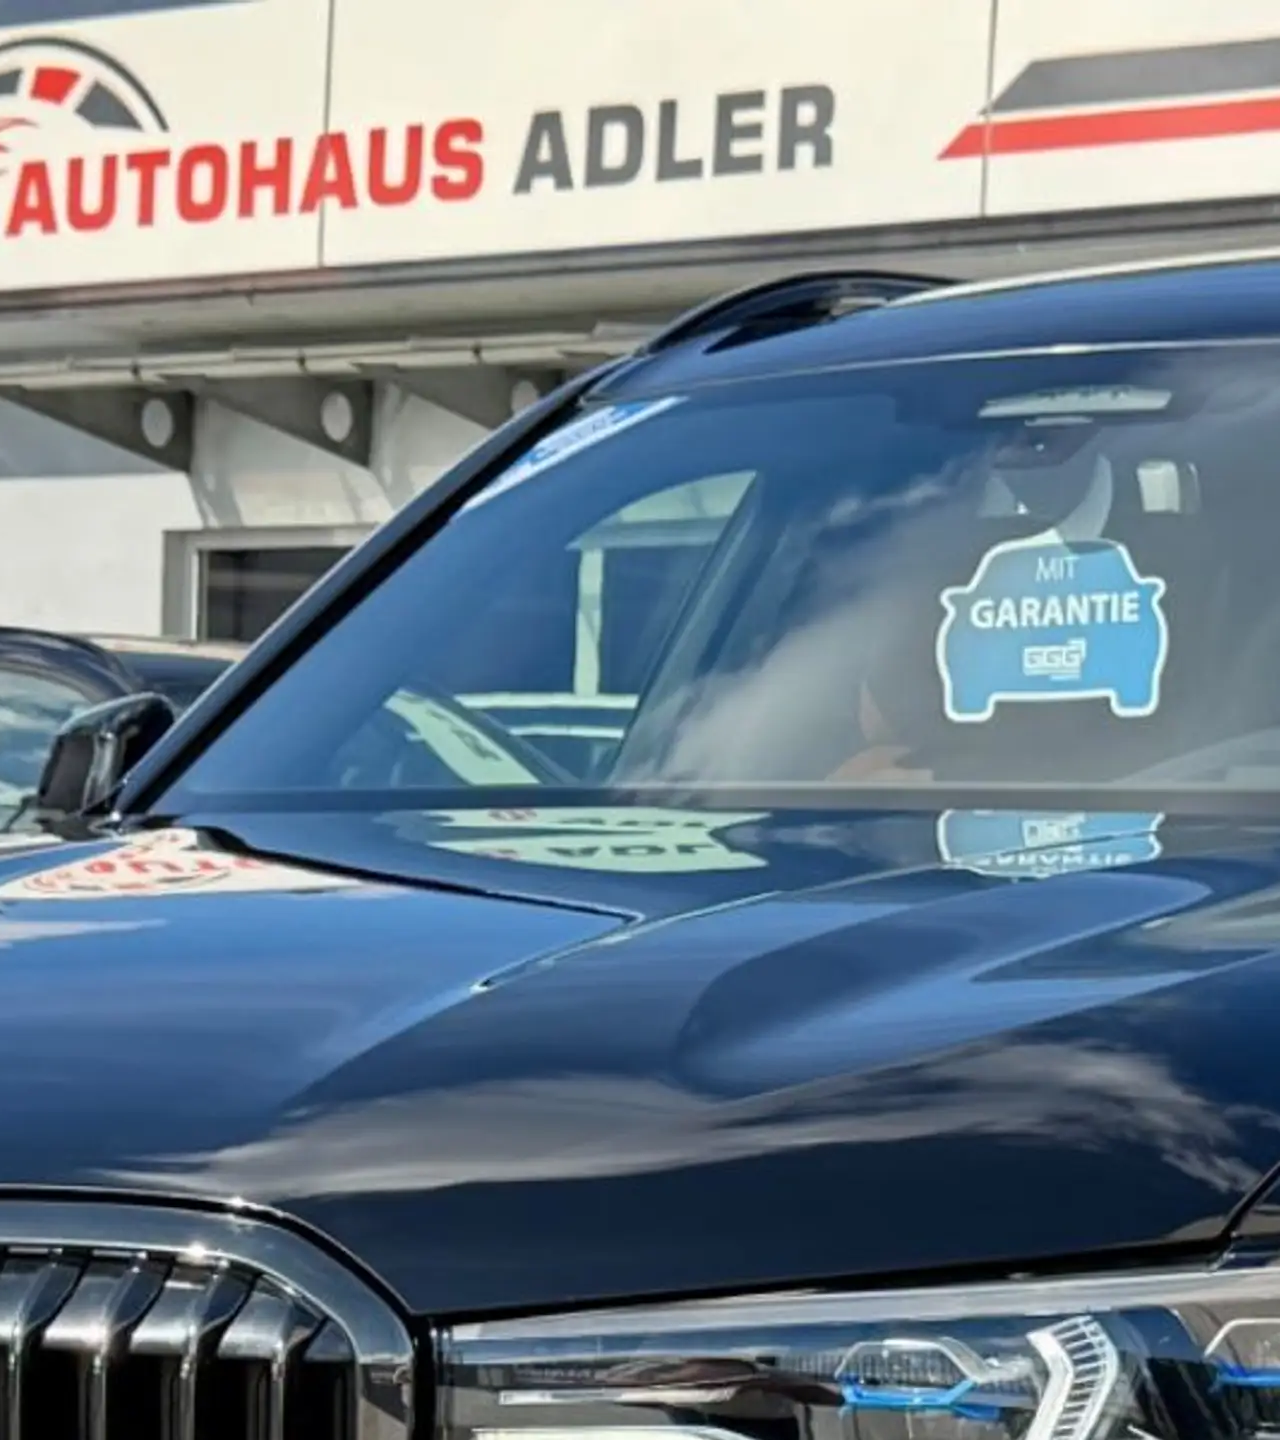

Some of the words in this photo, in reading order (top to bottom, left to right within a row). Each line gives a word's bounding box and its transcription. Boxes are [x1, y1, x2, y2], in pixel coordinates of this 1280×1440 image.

[6, 118, 484, 236] AUTOHAUS
[514, 84, 836, 194] ADLER
[1034, 554, 1080, 583] MIT
[969, 591, 1142, 629] GARANTIE
